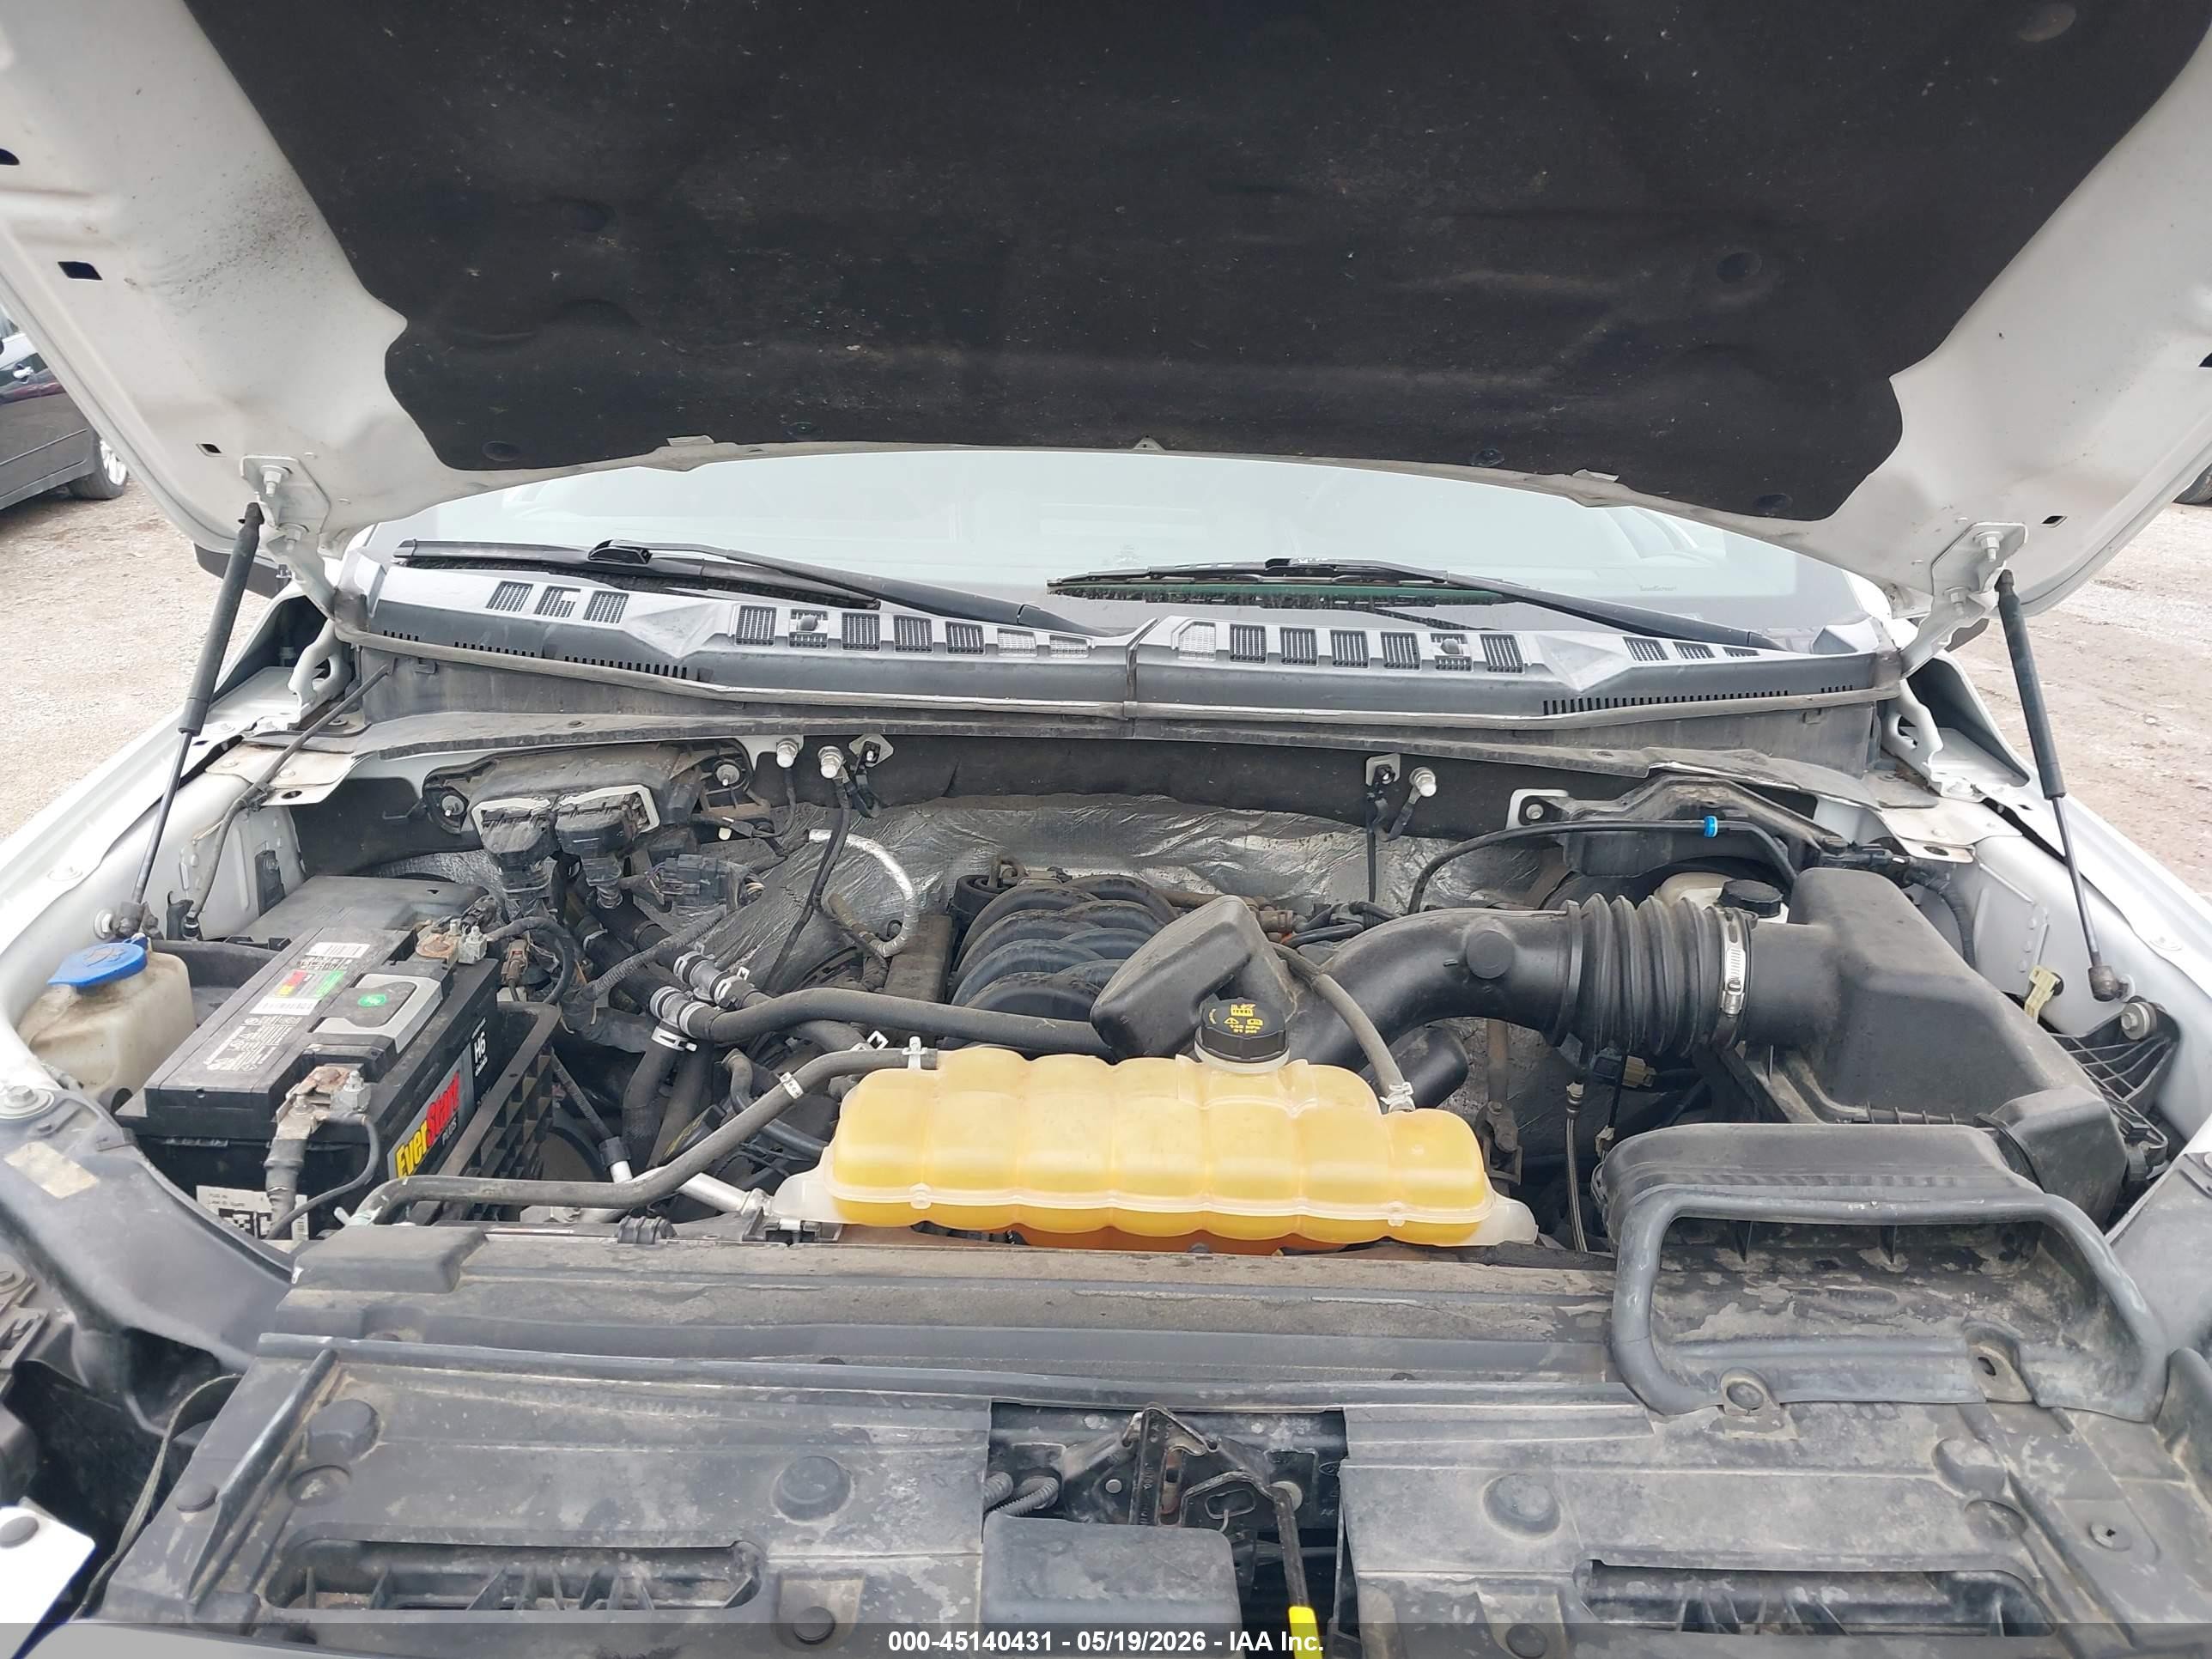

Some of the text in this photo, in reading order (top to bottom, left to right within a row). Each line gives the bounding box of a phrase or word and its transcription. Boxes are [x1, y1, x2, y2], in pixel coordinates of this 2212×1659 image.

[473, 1030, 486, 1064] H6
[395, 1070, 460, 1180] EverStart
[441, 1116, 458, 1146] PLUS
